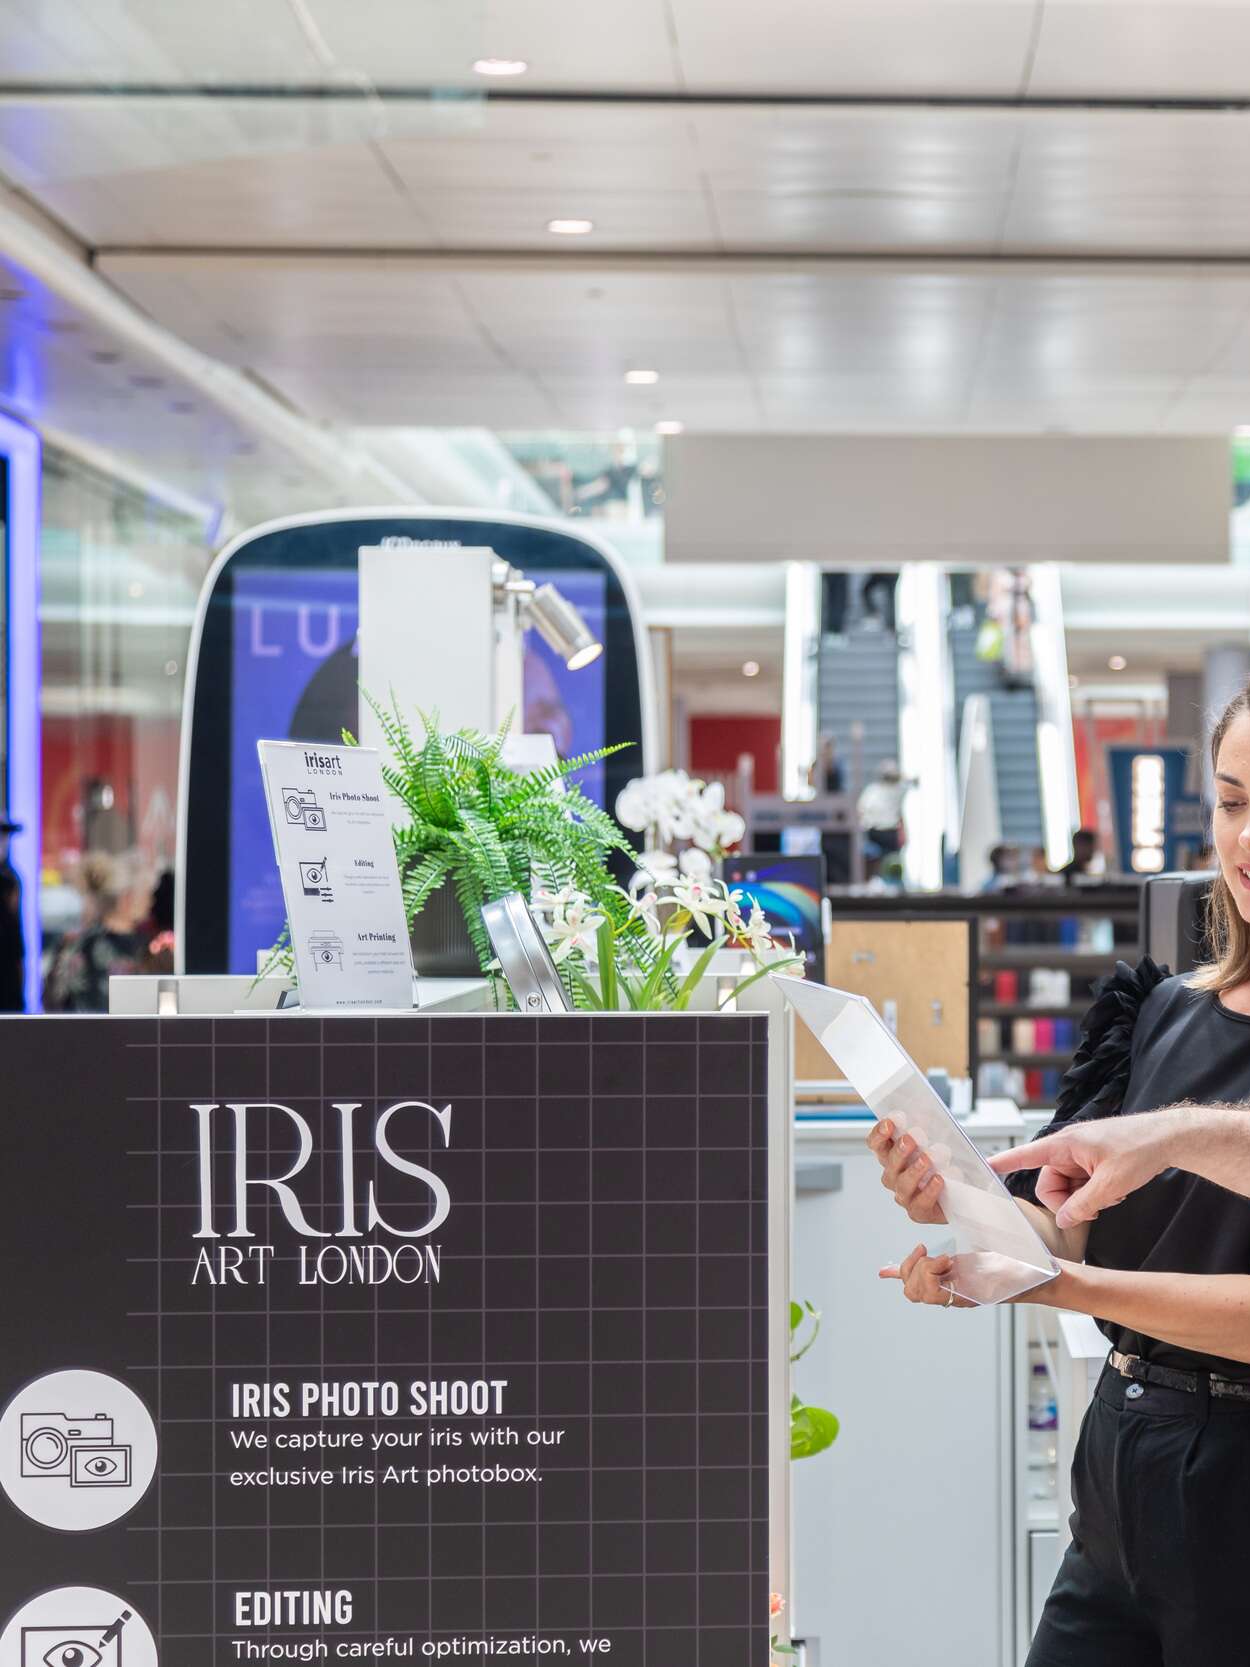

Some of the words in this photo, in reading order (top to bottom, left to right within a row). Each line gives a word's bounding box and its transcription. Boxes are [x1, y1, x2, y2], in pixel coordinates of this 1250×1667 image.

[251, 604, 361, 658] LU
[304, 751, 342, 770] irisart
[329, 792, 342, 801] Iris
[342, 792, 361, 801] Photo
[362, 793, 380, 802] Shoot
[354, 859, 375, 868] Editing
[357, 932, 369, 941] Art
[369, 932, 396, 943] Printing
[189, 1101, 452, 1238] IRIS
[191, 1245, 275, 1285] ART
[299, 1244, 443, 1285] LONDON
[232, 1383, 291, 1418] IRIS
[302, 1381, 399, 1417] PHOTO
[410, 1380, 508, 1416] SHOOT
[230, 1430, 268, 1449] We
[275, 1430, 364, 1452] capture
[371, 1431, 423, 1451] your
[430, 1428, 463, 1447] iris
[470, 1427, 519, 1446] with
[527, 1429, 565, 1446] our
[230, 1466, 334, 1486] exclusive
[342, 1466, 375, 1485] Iris
[382, 1465, 419, 1485] Art
[427, 1463, 543, 1487] photobox.
[235, 1590, 353, 1626] EDITING
[231, 1640, 328, 1662] Through
[336, 1637, 414, 1658] careful
[421, 1636, 571, 1660] optimization,
[579, 1638, 612, 1654] we
